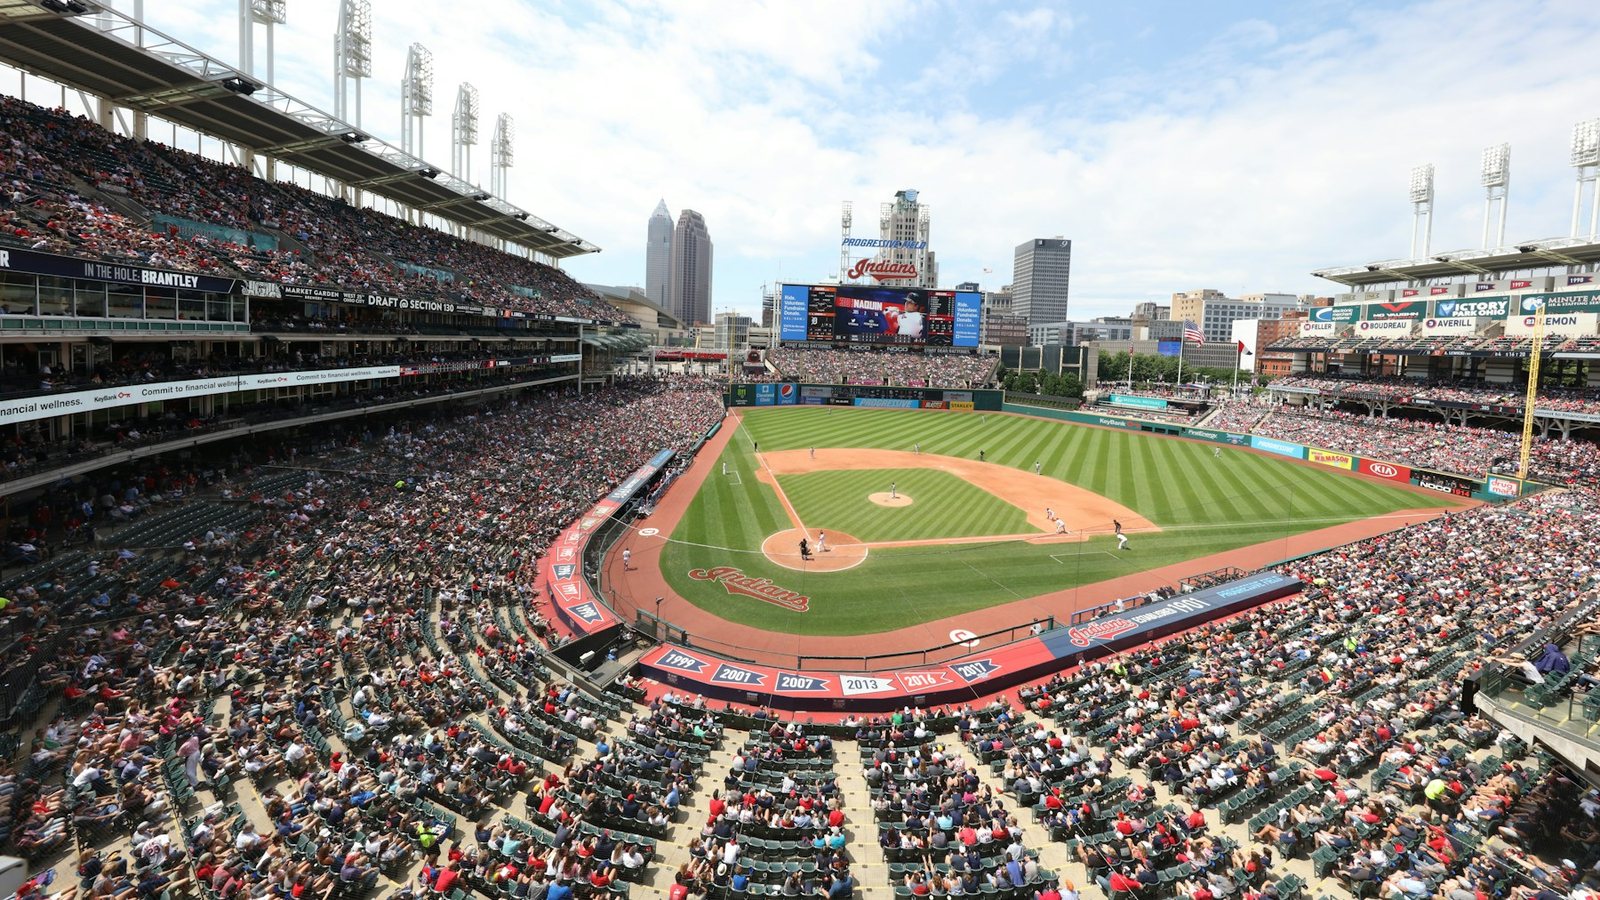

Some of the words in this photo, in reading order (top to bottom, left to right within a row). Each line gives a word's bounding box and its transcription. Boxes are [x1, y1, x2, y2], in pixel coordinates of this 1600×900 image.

[842, 238, 900, 249] PROGRESSIVE
[902, 241, 927, 250] FIELD
[84, 262, 94, 277] IN
[96, 264, 112, 279] THE
[114, 267, 140, 282] HOLE:
[141, 269, 199, 288] BRANTLEY
[848, 258, 917, 281] Indians
[285, 286, 312, 295] MARKET
[313, 289, 339, 298] GARDEN
[368, 295, 398, 307] DRAFT
[400, 299, 408, 308] @
[410, 300, 442, 311] SECTION
[443, 304, 454, 312] 130
[853, 298, 883, 311] NAQUIN
[1548, 295, 1589, 304] MINUTE
[1440, 300, 1507, 316] VICTORY
[1438, 319, 1472, 327] AVERILL
[1543, 316, 1577, 326] EMON
[257, 377, 277, 385] KeyBank
[328, 371, 350, 379] financial
[141, 386, 173, 396] Commit
[185, 382, 216, 391] financial
[40, 398, 83, 410] wellness.
[94, 393, 117, 403] KeyBank
[860, 400, 913, 408] PROGRESSIVE
[1100, 418, 1126, 427] KeyBank
[1374, 464, 1392, 475] KIA
[1420, 481, 1451, 493] NOCO
[1452, 487, 1470, 497] 1914
[1491, 479, 1512, 490] drug
[688, 566, 811, 612] Indians
[575, 604, 597, 618] 1998
[1068, 617, 1139, 648] Indians
[1131, 606, 1178, 624] ESTABLISHED
[1167, 597, 1211, 614] 1901
[665, 653, 696, 669] 1999
[719, 668, 752, 683] 2001
[957, 662, 987, 677] 2017
[781, 677, 814, 690] 2007
[846, 679, 878, 690] 2013
[904, 675, 937, 687] 2016
